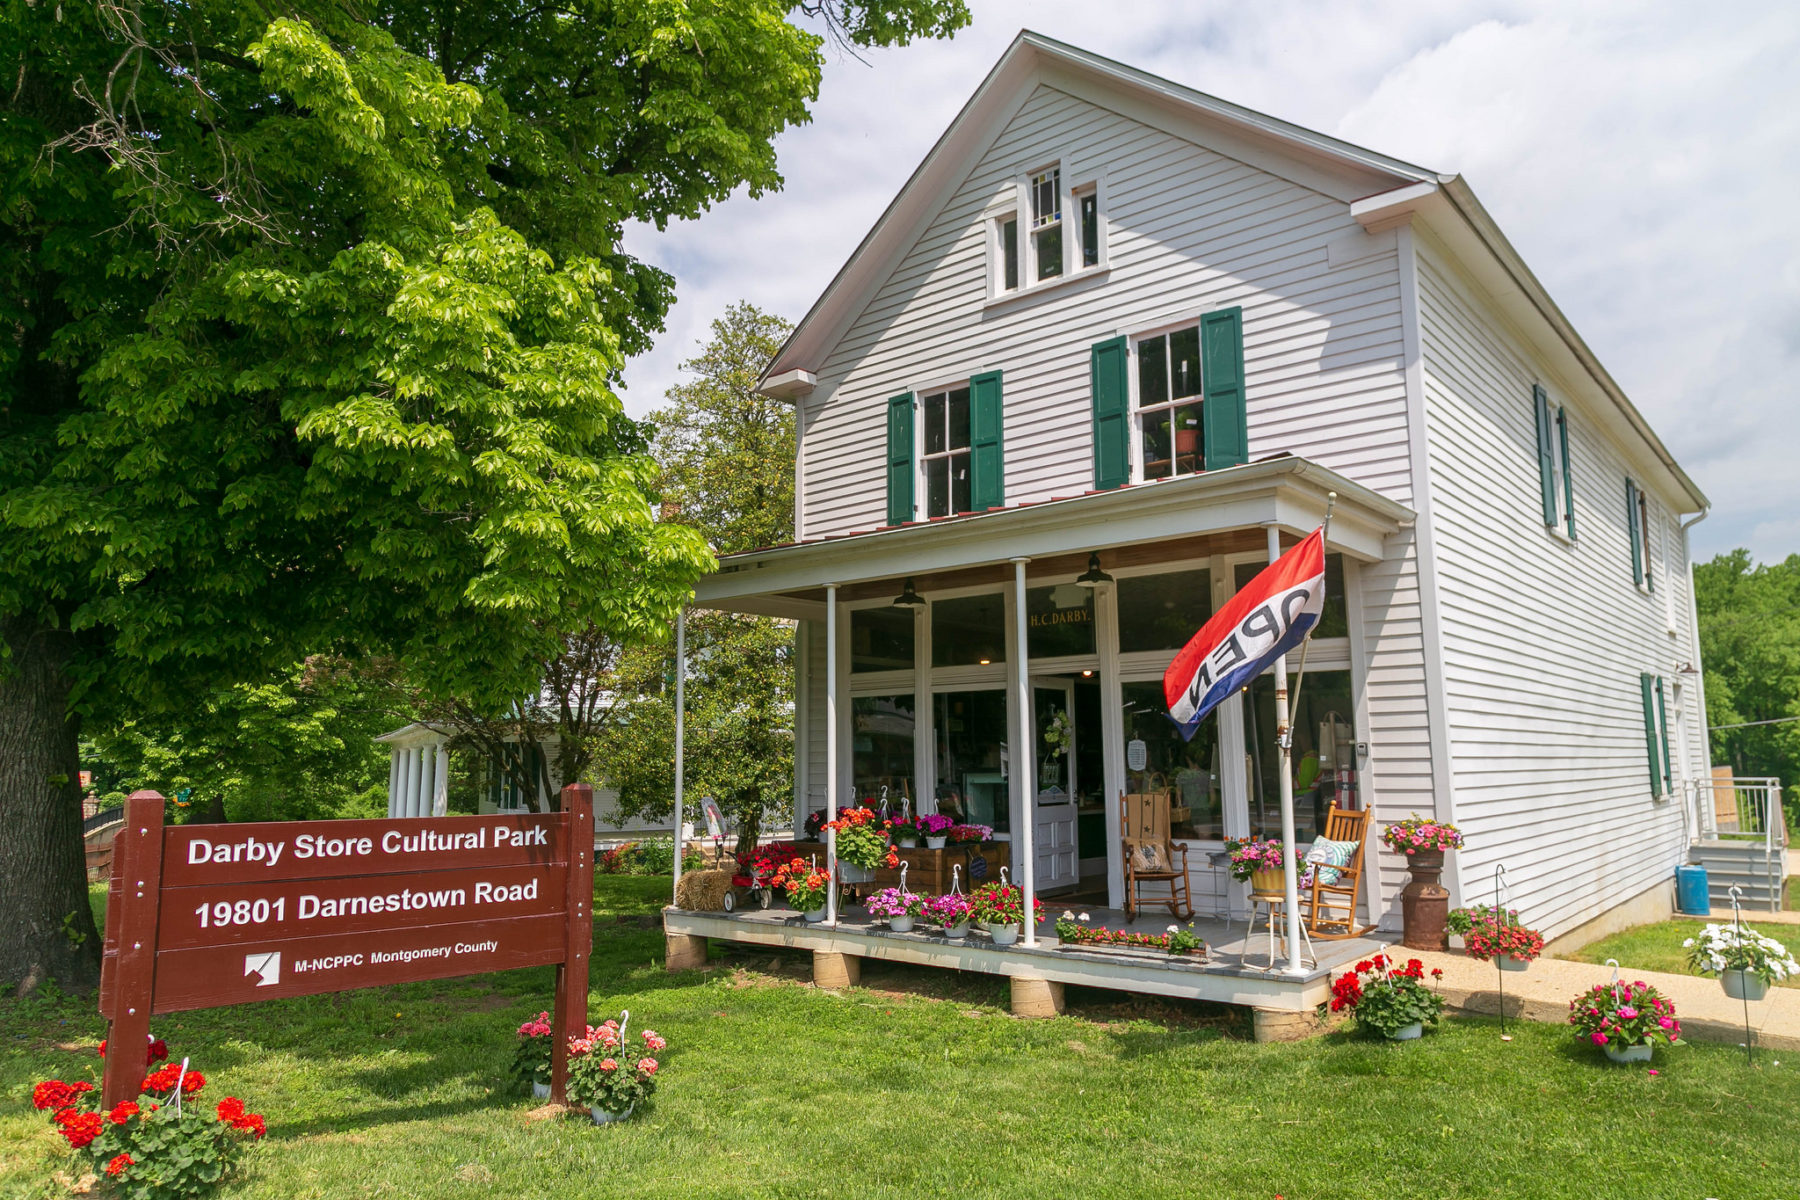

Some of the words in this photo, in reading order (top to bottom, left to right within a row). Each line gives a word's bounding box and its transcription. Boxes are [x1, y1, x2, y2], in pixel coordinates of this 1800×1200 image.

[187, 837, 285, 867] Darby
[294, 834, 373, 859] Store
[381, 827, 486, 854] Cultural
[494, 825, 548, 848] Park
[194, 897, 285, 929] 19801
[298, 888, 466, 920] Darnestown
[474, 878, 538, 904] Road
[294, 954, 364, 973] M-NCPPC
[370, 946, 452, 964] Montgomery
[454, 940, 498, 955] County
